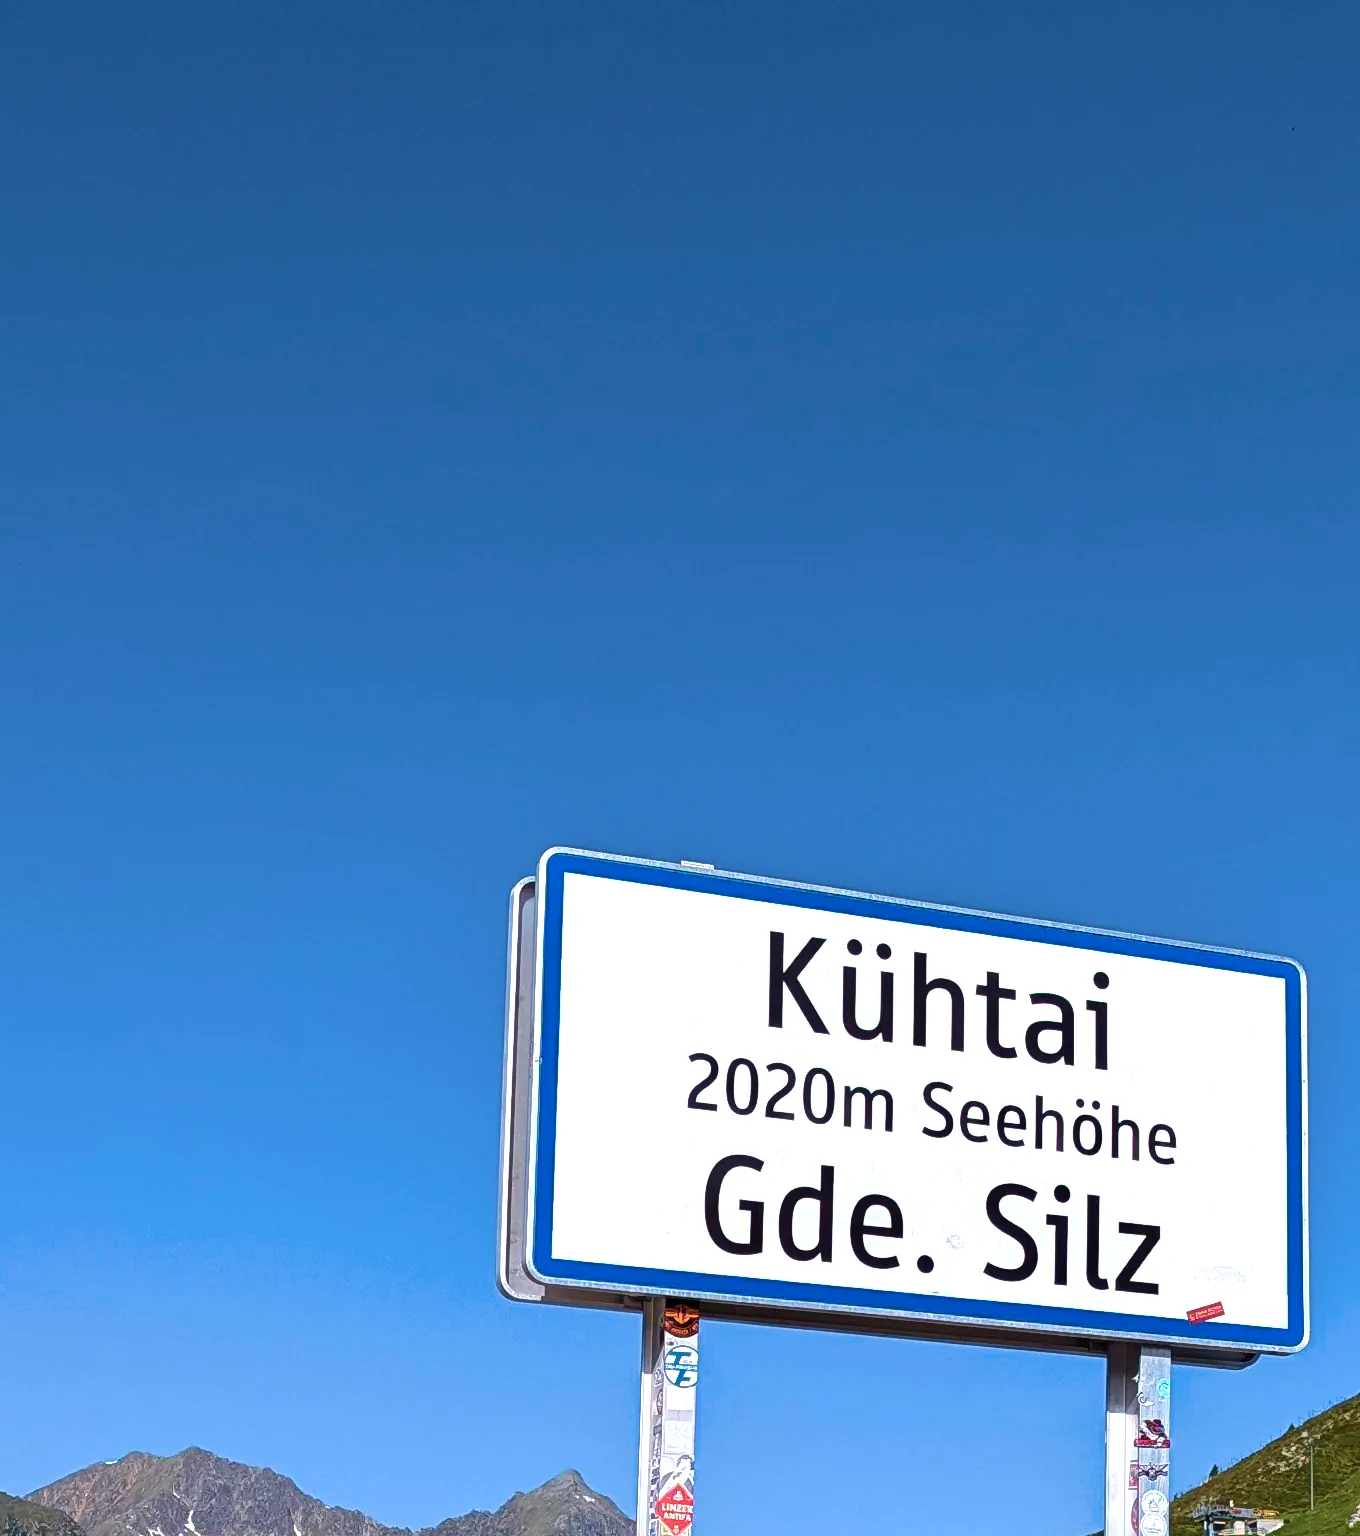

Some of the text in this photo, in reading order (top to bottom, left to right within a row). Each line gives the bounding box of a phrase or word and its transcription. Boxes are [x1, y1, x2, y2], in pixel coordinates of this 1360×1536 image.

[768, 930, 1111, 1071] Kühtai
[686, 1052, 1178, 1166] 2020m Seehöhe
[703, 1153, 1163, 1296] Gde. Silz
